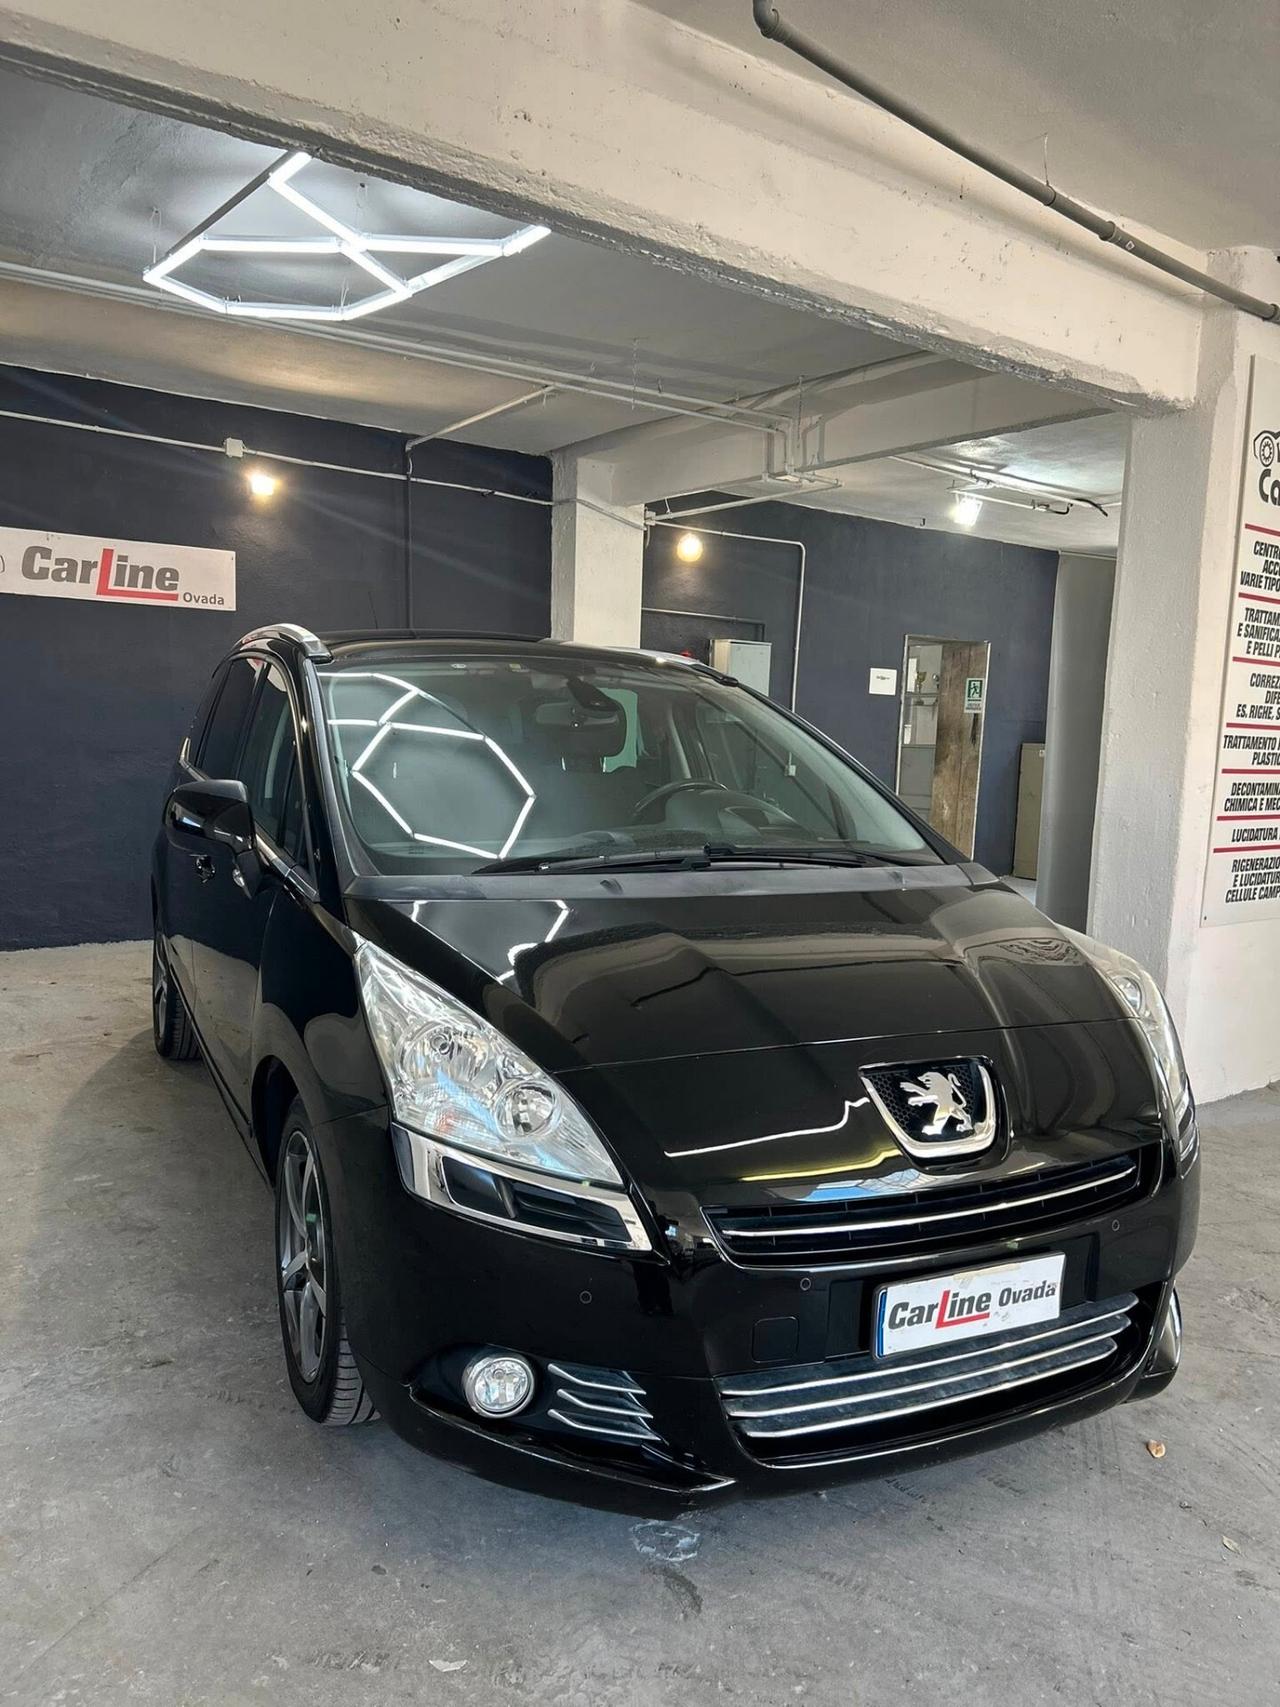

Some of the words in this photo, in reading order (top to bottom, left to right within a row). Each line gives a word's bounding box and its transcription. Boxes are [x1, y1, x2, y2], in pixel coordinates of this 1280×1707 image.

[1253, 541, 1280, 560] CENTR
[21, 545, 179, 601] CarLine
[183, 592, 225, 605] Ovada
[1262, 559, 1280, 577] ACC
[1240, 571, 1263, 589] VARIE
[1237, 622, 1243, 637] E
[1244, 624, 1280, 642] SANIFICA
[1246, 640, 1252, 654] E
[1252, 641, 1274, 657] PELLI
[1274, 644, 1280, 659] P
[1250, 673, 1280, 689] CORREZ
[1249, 705, 1274, 720] RIGHE,
[1223, 735, 1276, 750] TRATTAMENTO
[1224, 798, 1257, 812] CHIMICA
[1259, 798, 1264, 811] E
[1232, 827, 1278, 842] LUCIDATURA
[1233, 874, 1239, 887] E
[1226, 887, 1258, 903] CELLULE
[1259, 886, 1280, 900] CAMP
[888, 1290, 992, 1329] CarLine
[998, 1280, 1056, 1307] Ovada
